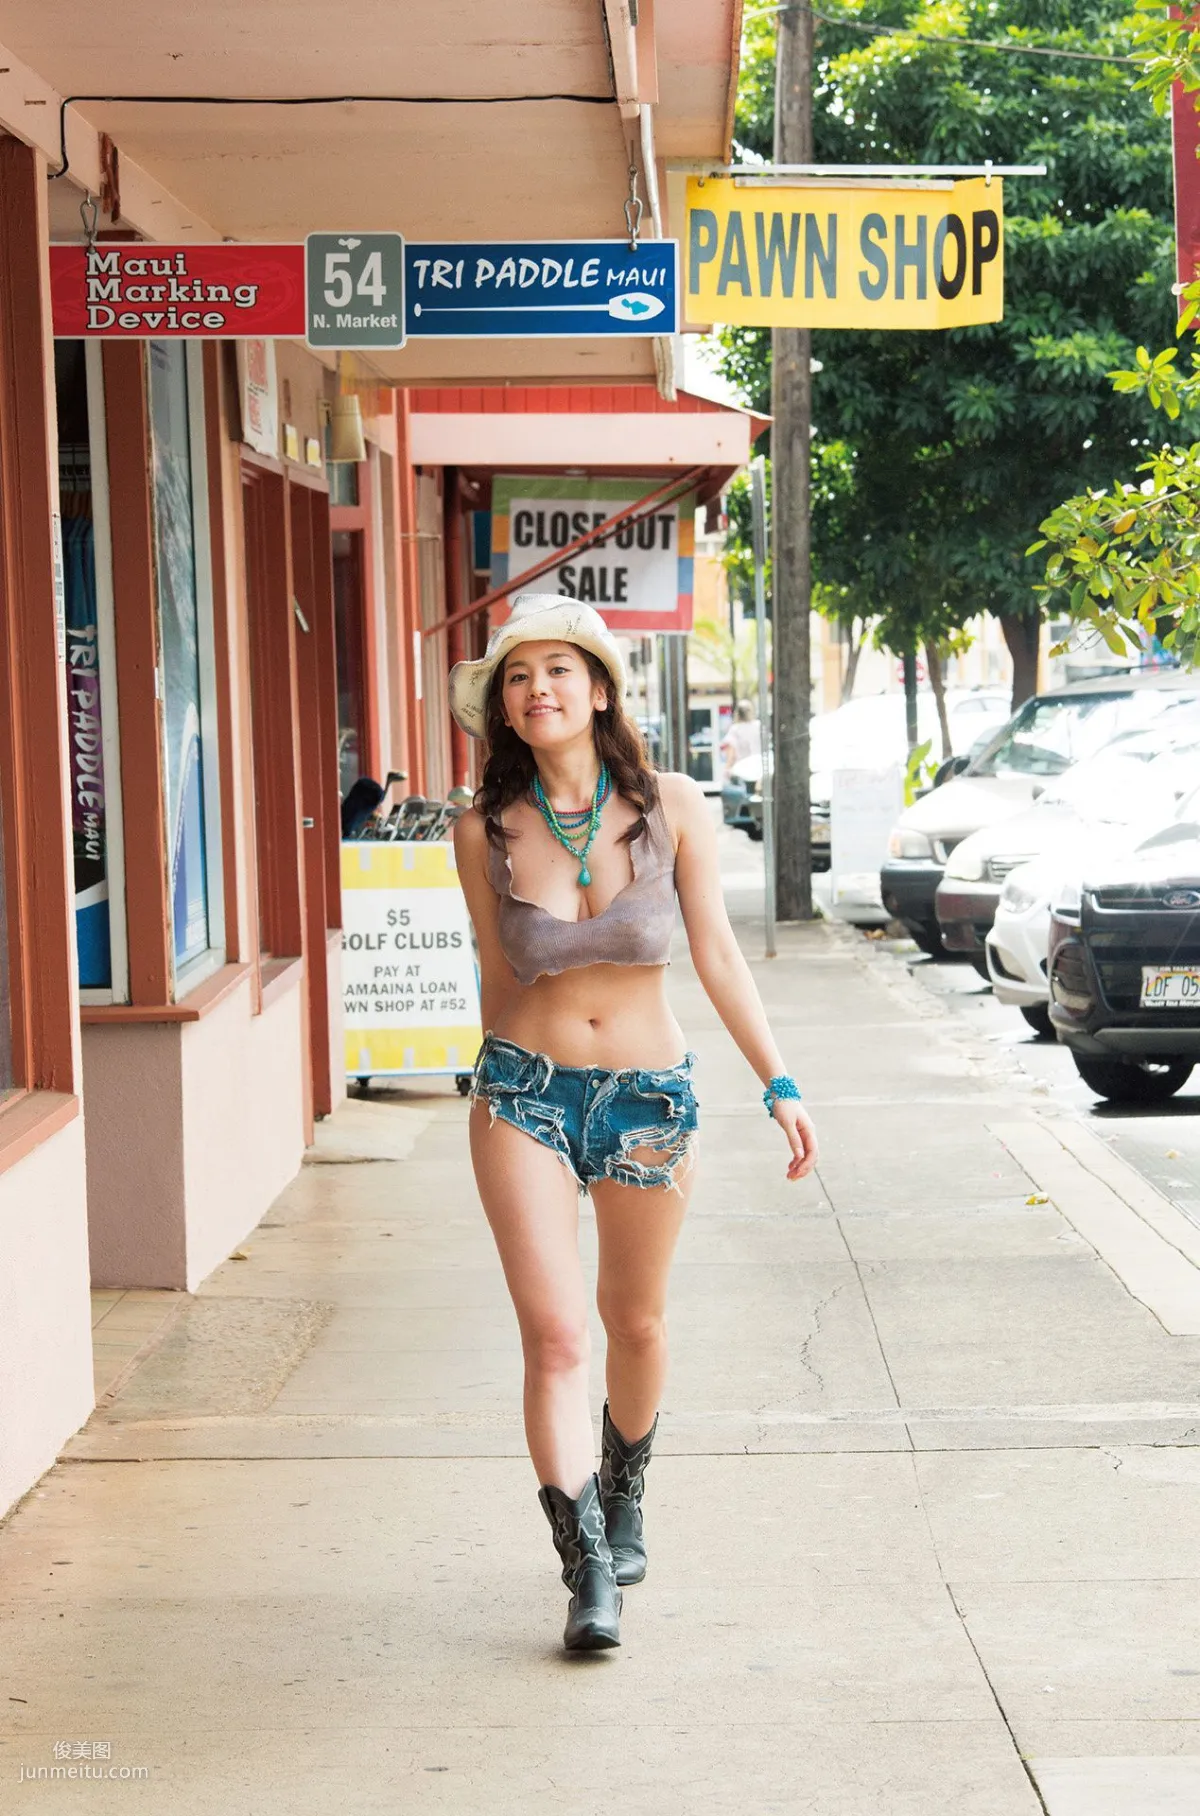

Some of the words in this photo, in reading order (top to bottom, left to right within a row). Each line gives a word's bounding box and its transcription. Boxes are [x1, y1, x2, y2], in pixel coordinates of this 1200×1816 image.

[86, 252, 187, 276] Maui
[689, 208, 838, 299] PAWN
[858, 209, 999, 301] SHOP
[323, 251, 387, 308] 54
[413, 259, 464, 289] TRI
[475, 257, 600, 289] PADDLE
[606, 267, 665, 287] MAUI
[86, 278, 259, 308] Marking
[86, 305, 226, 330] Device
[313, 314, 330, 328] N.
[336, 313, 397, 328] Market
[514, 510, 606, 548] CLOSE
[615, 513, 675, 550] OUT
[558, 565, 628, 602] SALE
[67, 625, 97, 679] TRI
[71, 687, 105, 808] PADDLE
[82, 811, 100, 860] MAUI
[387, 909, 410, 927] $5
[394, 931, 463, 949] CLUBS
[374, 965, 400, 978] PAY
[405, 965, 421, 977] AT
[344, 983, 414, 996] AMAAINA
[420, 982, 457, 994] LOAN
[374, 1000, 414, 1013] SHOP
[420, 999, 435, 1011] AT
[440, 998, 466, 1011] #52
